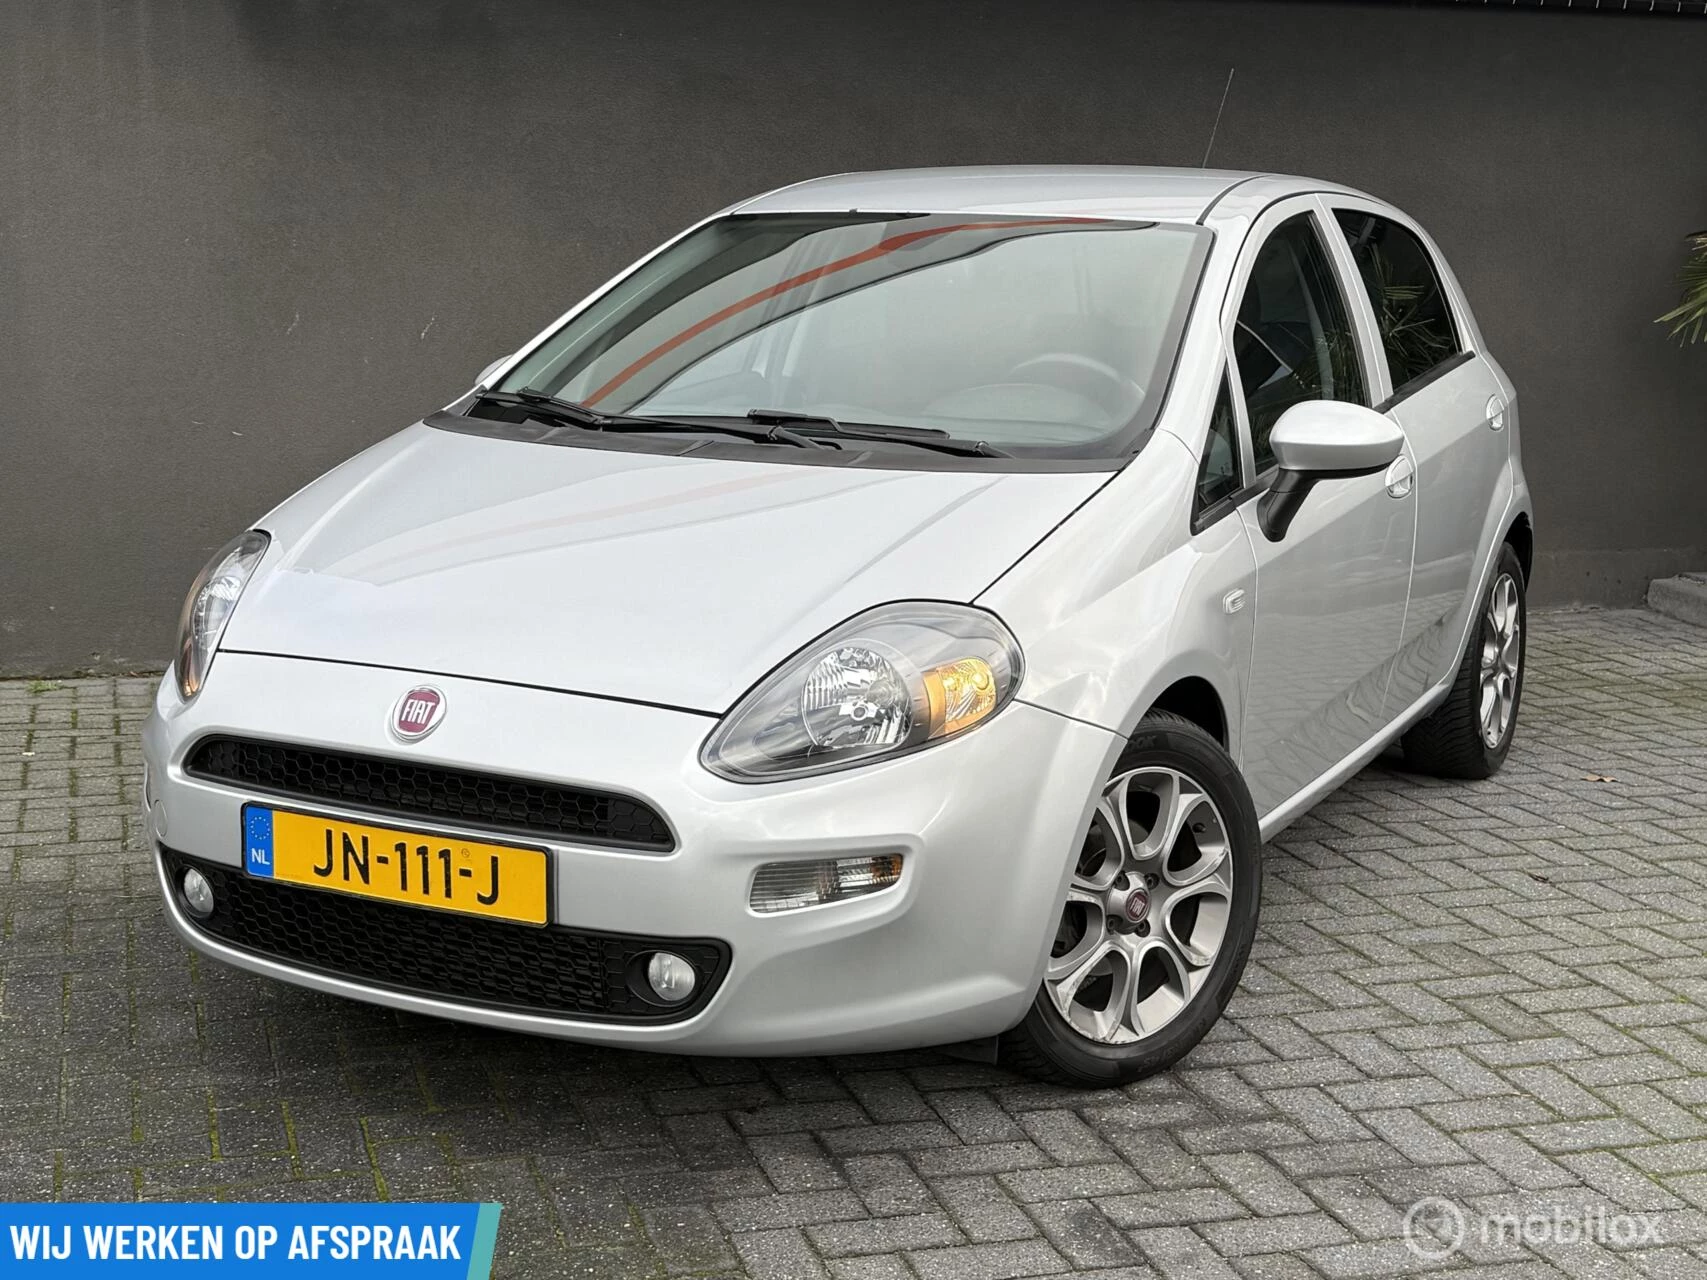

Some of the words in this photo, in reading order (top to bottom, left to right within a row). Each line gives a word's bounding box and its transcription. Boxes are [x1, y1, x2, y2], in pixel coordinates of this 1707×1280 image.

[401, 698, 436, 725] FIAT
[251, 848, 270, 865] NL
[313, 828, 499, 906] JN-111-J
